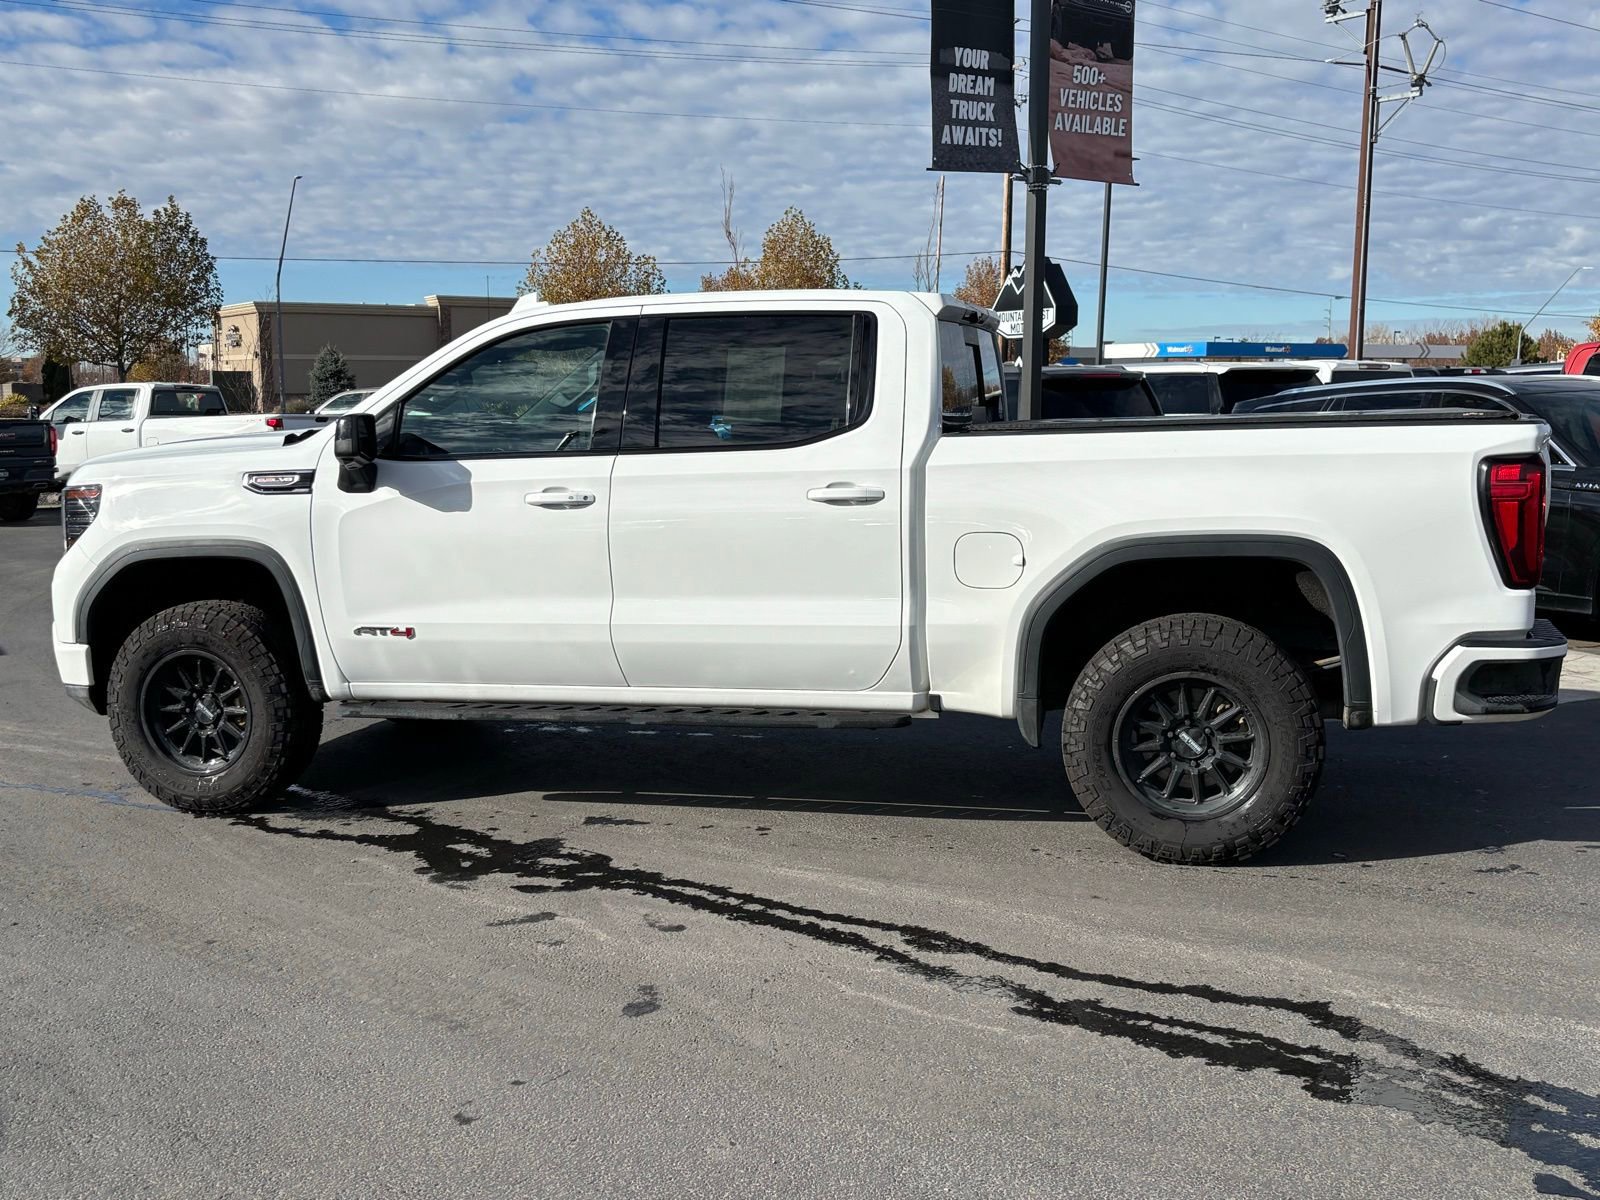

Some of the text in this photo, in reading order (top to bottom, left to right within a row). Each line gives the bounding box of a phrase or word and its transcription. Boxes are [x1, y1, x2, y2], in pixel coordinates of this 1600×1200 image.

[954, 47, 990, 71] YOUR
[948, 72, 995, 97] DREAM
[1072, 64, 1107, 86] 500+
[950, 99, 996, 122] TRUCK
[1060, 88, 1123, 113] VEHICLES
[941, 125, 1003, 147] AWAITS!
[1054, 113, 1128, 137] AVAILABLE
[353, 626, 417, 640] AT4
